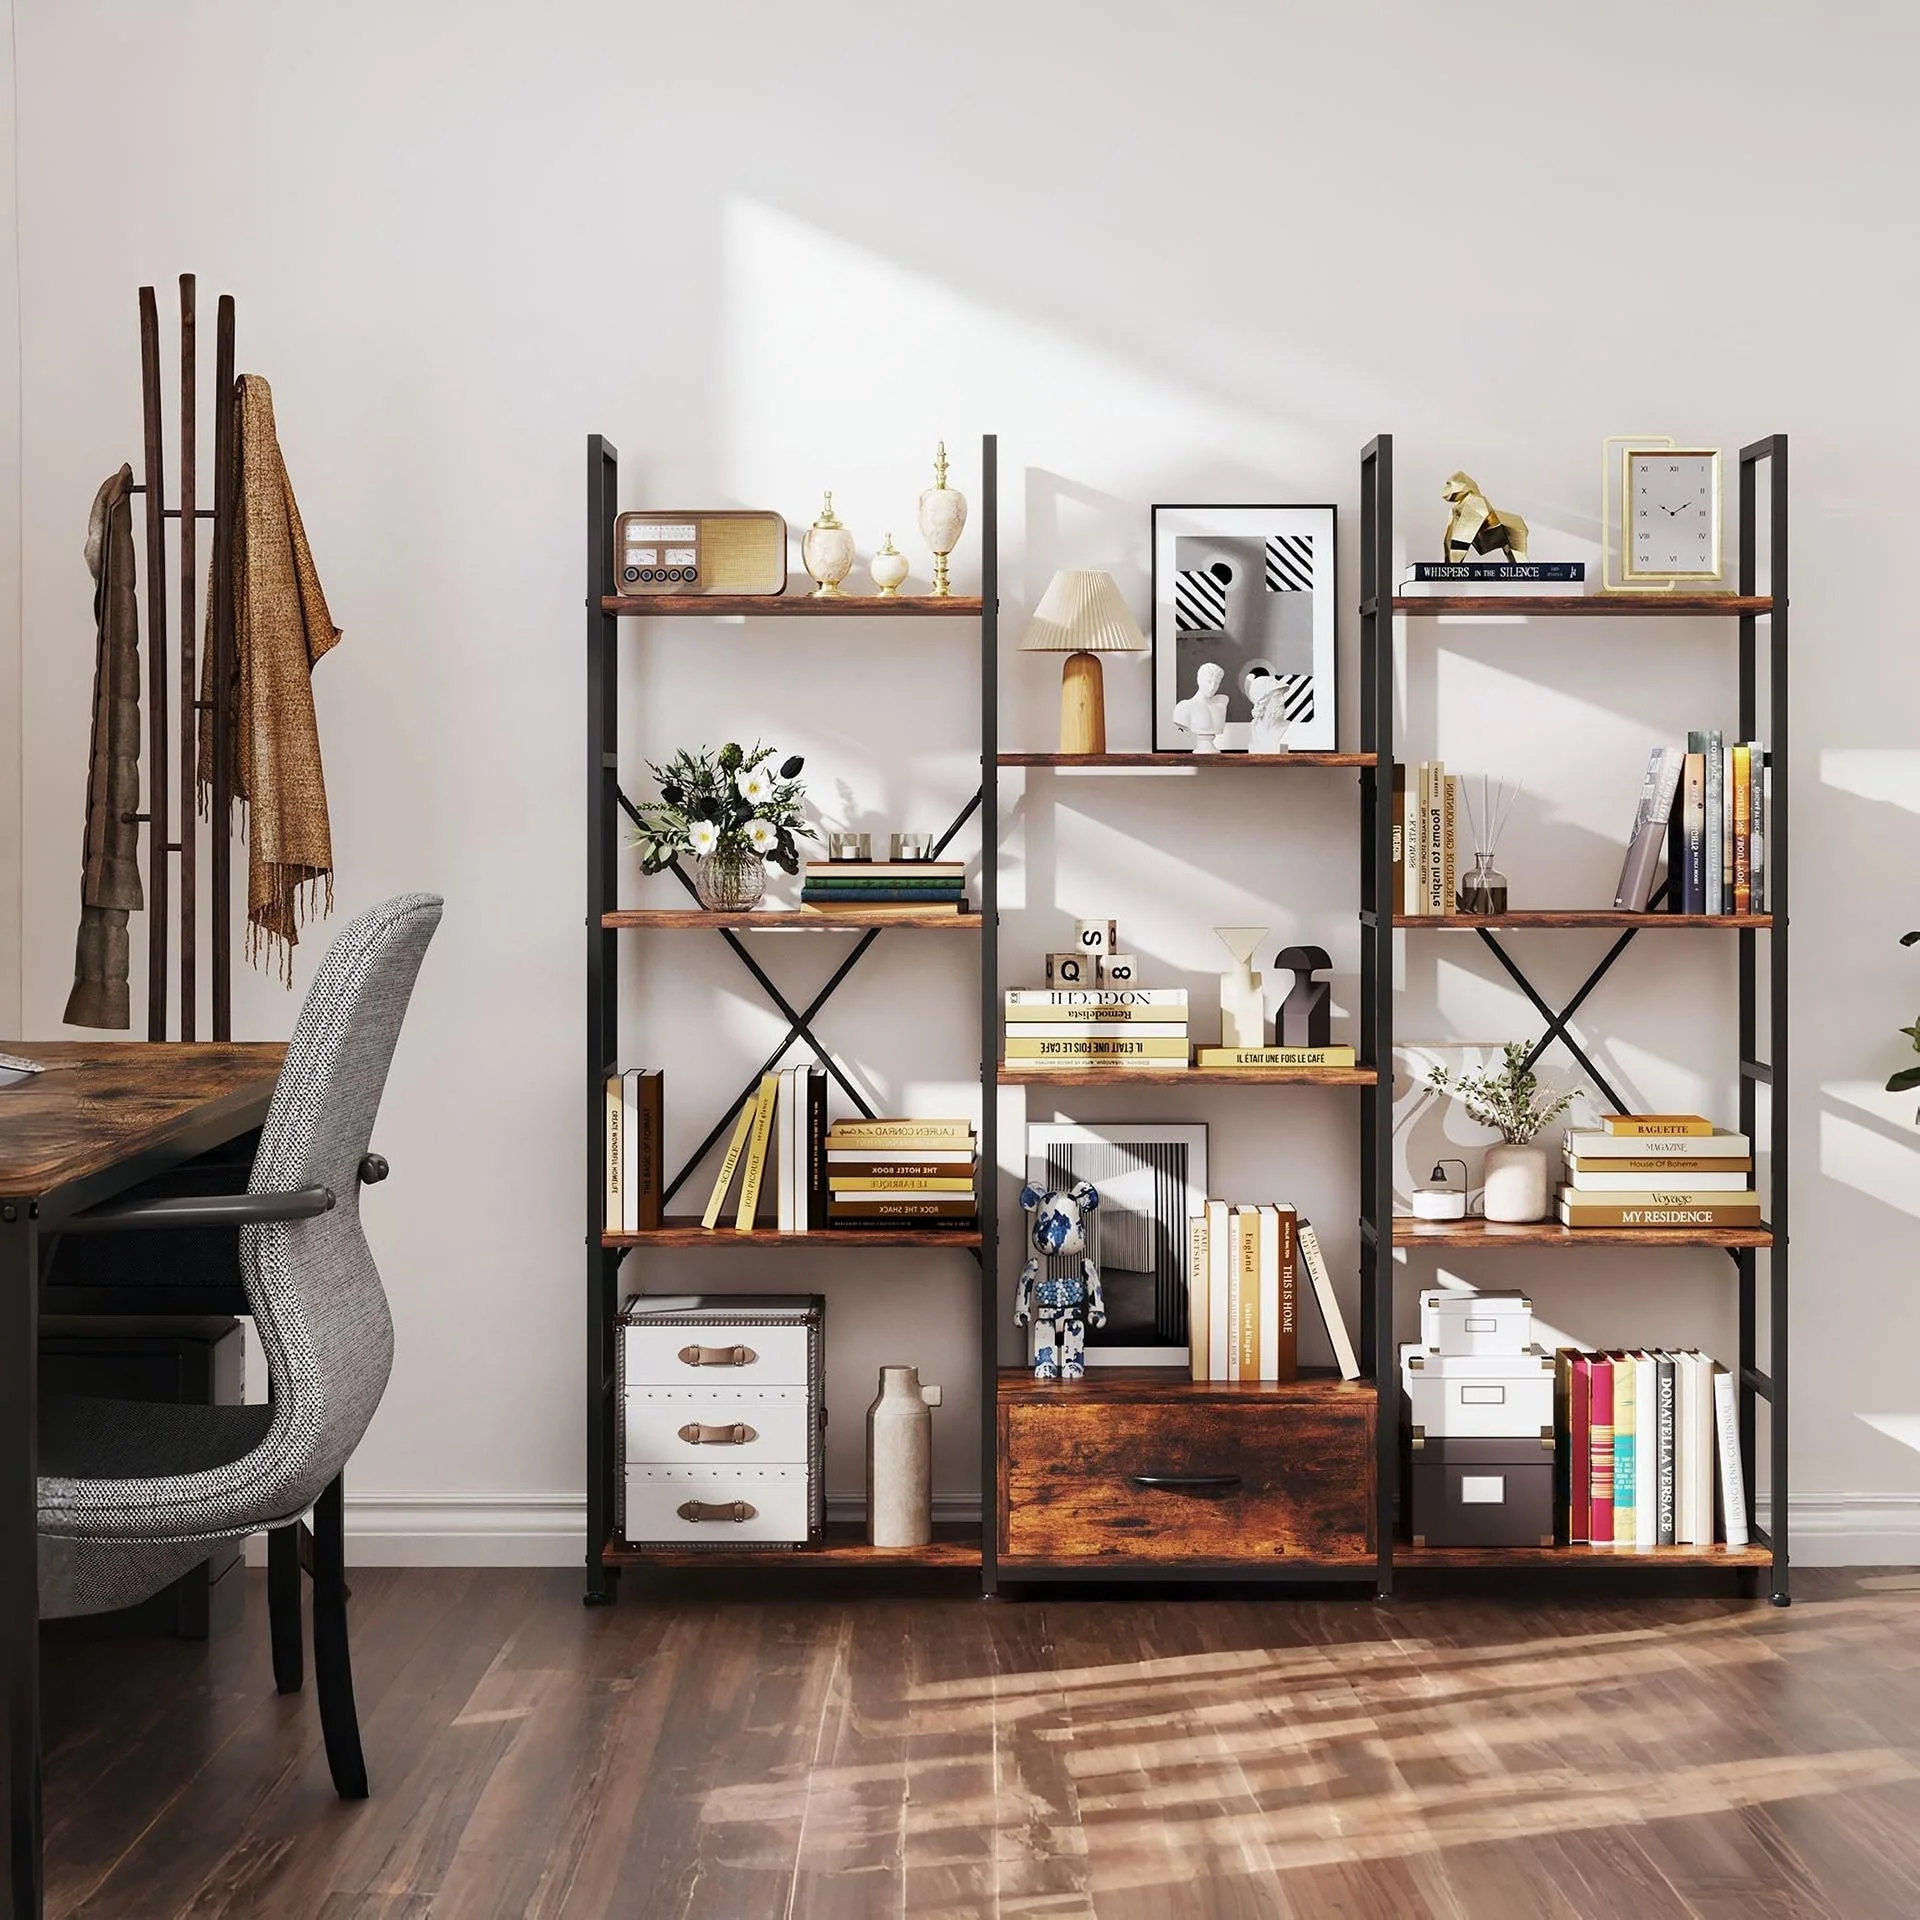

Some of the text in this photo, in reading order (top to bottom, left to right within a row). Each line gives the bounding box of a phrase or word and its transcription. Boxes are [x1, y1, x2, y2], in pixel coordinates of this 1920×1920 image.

[1641, 487, 1648, 495] X
[1423, 566, 1470, 578] WHISPERS
[1474, 569, 1483, 578] IN
[1483, 569, 1496, 578] THE
[1499, 566, 1540, 578] SILENCE
[1082, 930, 1102, 946] S
[1060, 960, 1081, 982] Q
[1111, 966, 1132, 980] 8
[1050, 991, 1151, 1005] NOGUCHI
[1067, 1010, 1132, 1020] Remodelista
[1040, 1042, 1144, 1056] IL ÉTAIT UNE FOIS LE CAFÉ
[1236, 1050, 1325, 1064] IL ÉTAIT UNE FOIS LE CAFÉ
[755, 1119, 766, 1143] second
[1637, 1125, 1689, 1134] BAGUETTE
[1645, 1143, 1688, 1152] MAGAZINE
[720, 1145, 740, 1186] SCHIELE
[747, 1154, 761, 1188] PICOULT
[1629, 1160, 1698, 1168] House Of Boheme
[1652, 1193, 1693, 1206] Voyage
[1622, 1211, 1713, 1223] MY RESIDENCE
[1307, 1232, 1319, 1258] PAUL
[1242, 1233, 1254, 1273] England
[1283, 1264, 1293, 1334] THIS IS HOME
[1244, 1302, 1253, 1329] United
[1661, 1377, 1673, 1532] DONATELLA VERSACE
